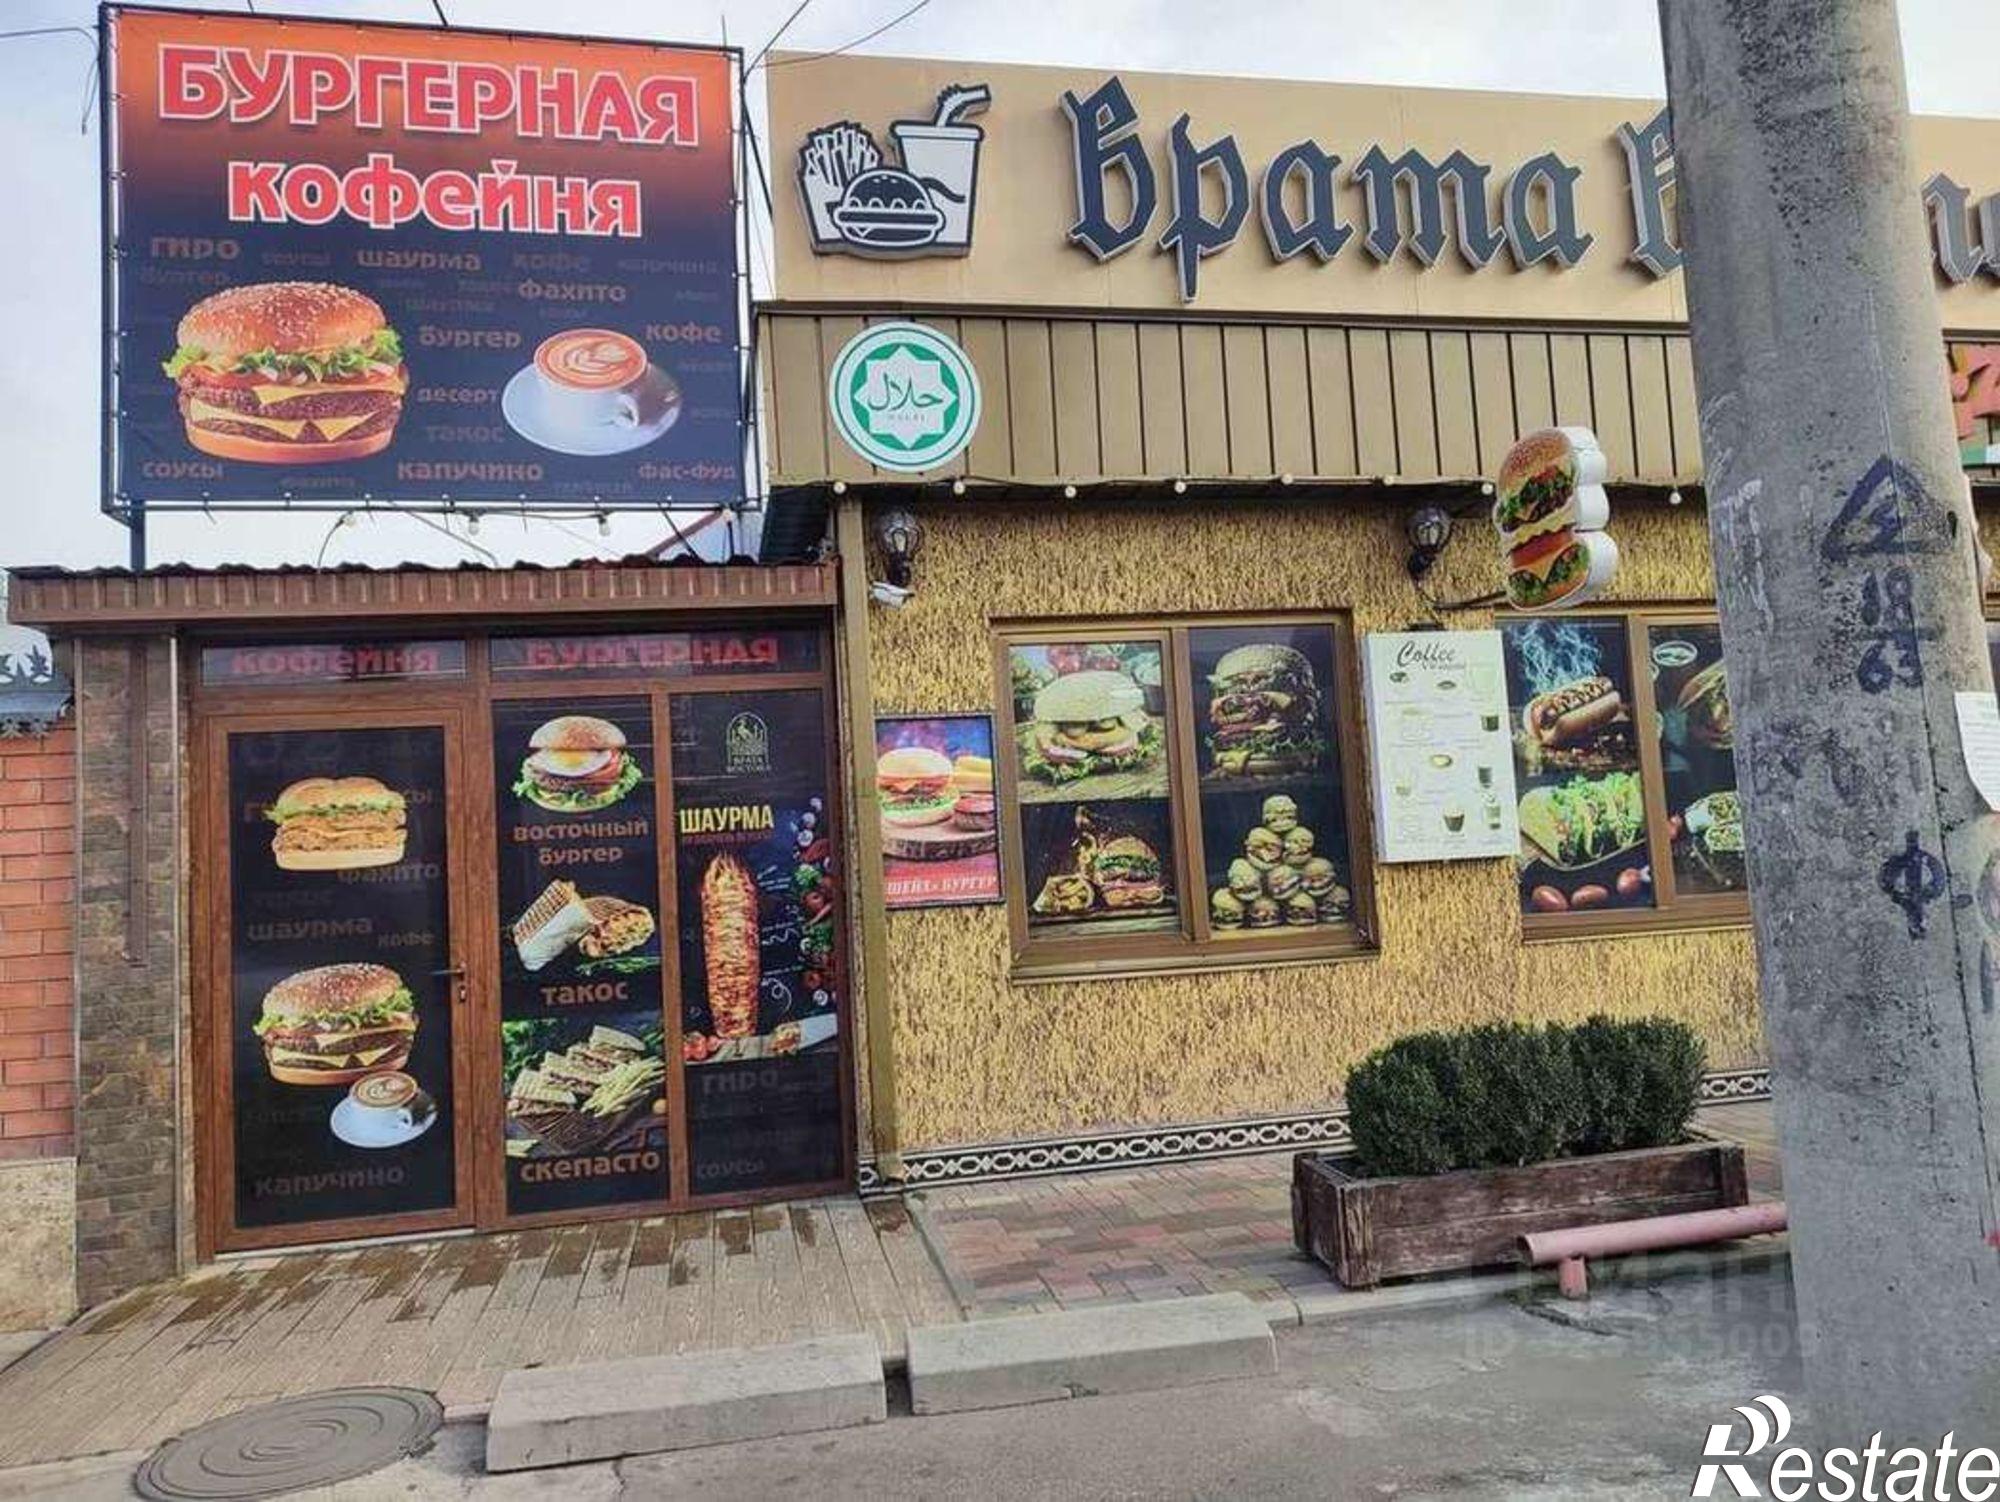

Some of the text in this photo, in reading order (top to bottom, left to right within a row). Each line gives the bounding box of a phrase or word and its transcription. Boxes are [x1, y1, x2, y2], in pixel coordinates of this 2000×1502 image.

[159, 44, 700, 148] БУРГЕРНАЯ
[228, 152, 642, 238] кофейня
[868, 371, 945, 412] حلال
[397, 461, 543, 481] капучино
[513, 820, 649, 843] восточный
[679, 804, 775, 835] ШАУРМА
[538, 845, 624, 867] бургер
[540, 981, 629, 1007] такос
[519, 1151, 661, 1184] скепасто
